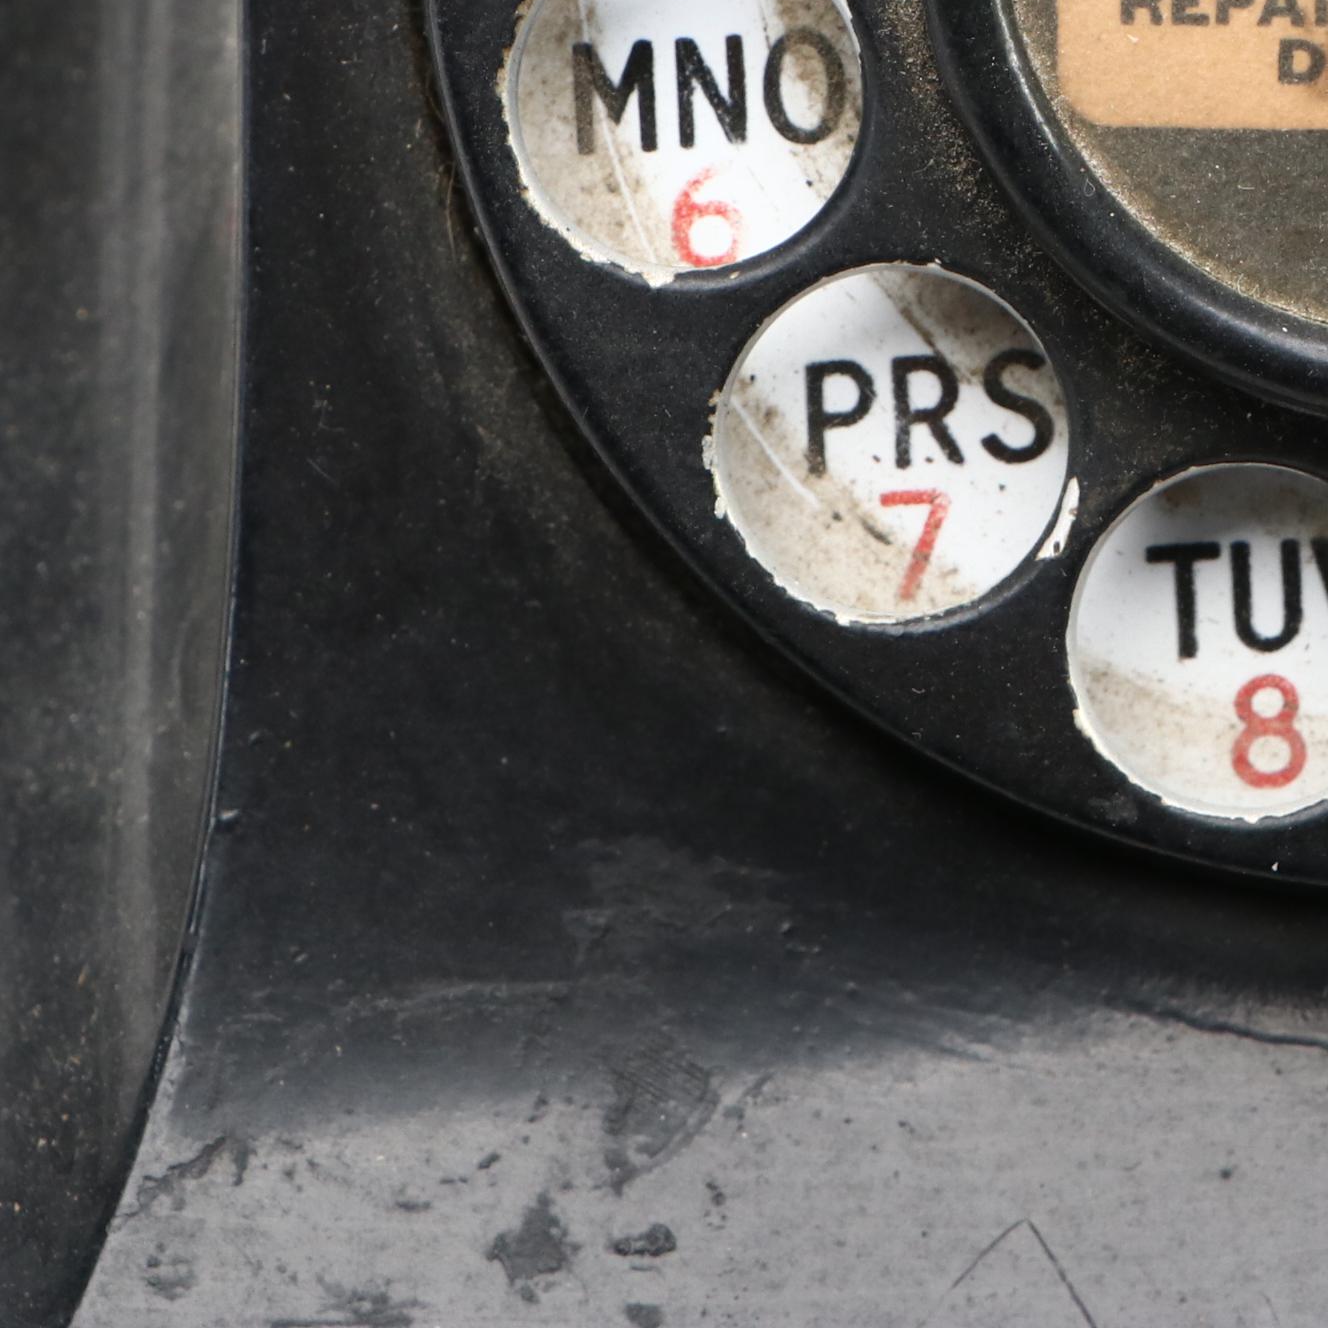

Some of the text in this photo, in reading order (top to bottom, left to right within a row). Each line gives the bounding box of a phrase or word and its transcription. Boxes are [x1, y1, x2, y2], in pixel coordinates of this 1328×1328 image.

[571, 29, 848, 156] MNO
[671, 164, 742, 268] 6
[802, 347, 1056, 477] PRS
[879, 488, 952, 602] 7
[1231, 672, 1307, 790] 8
